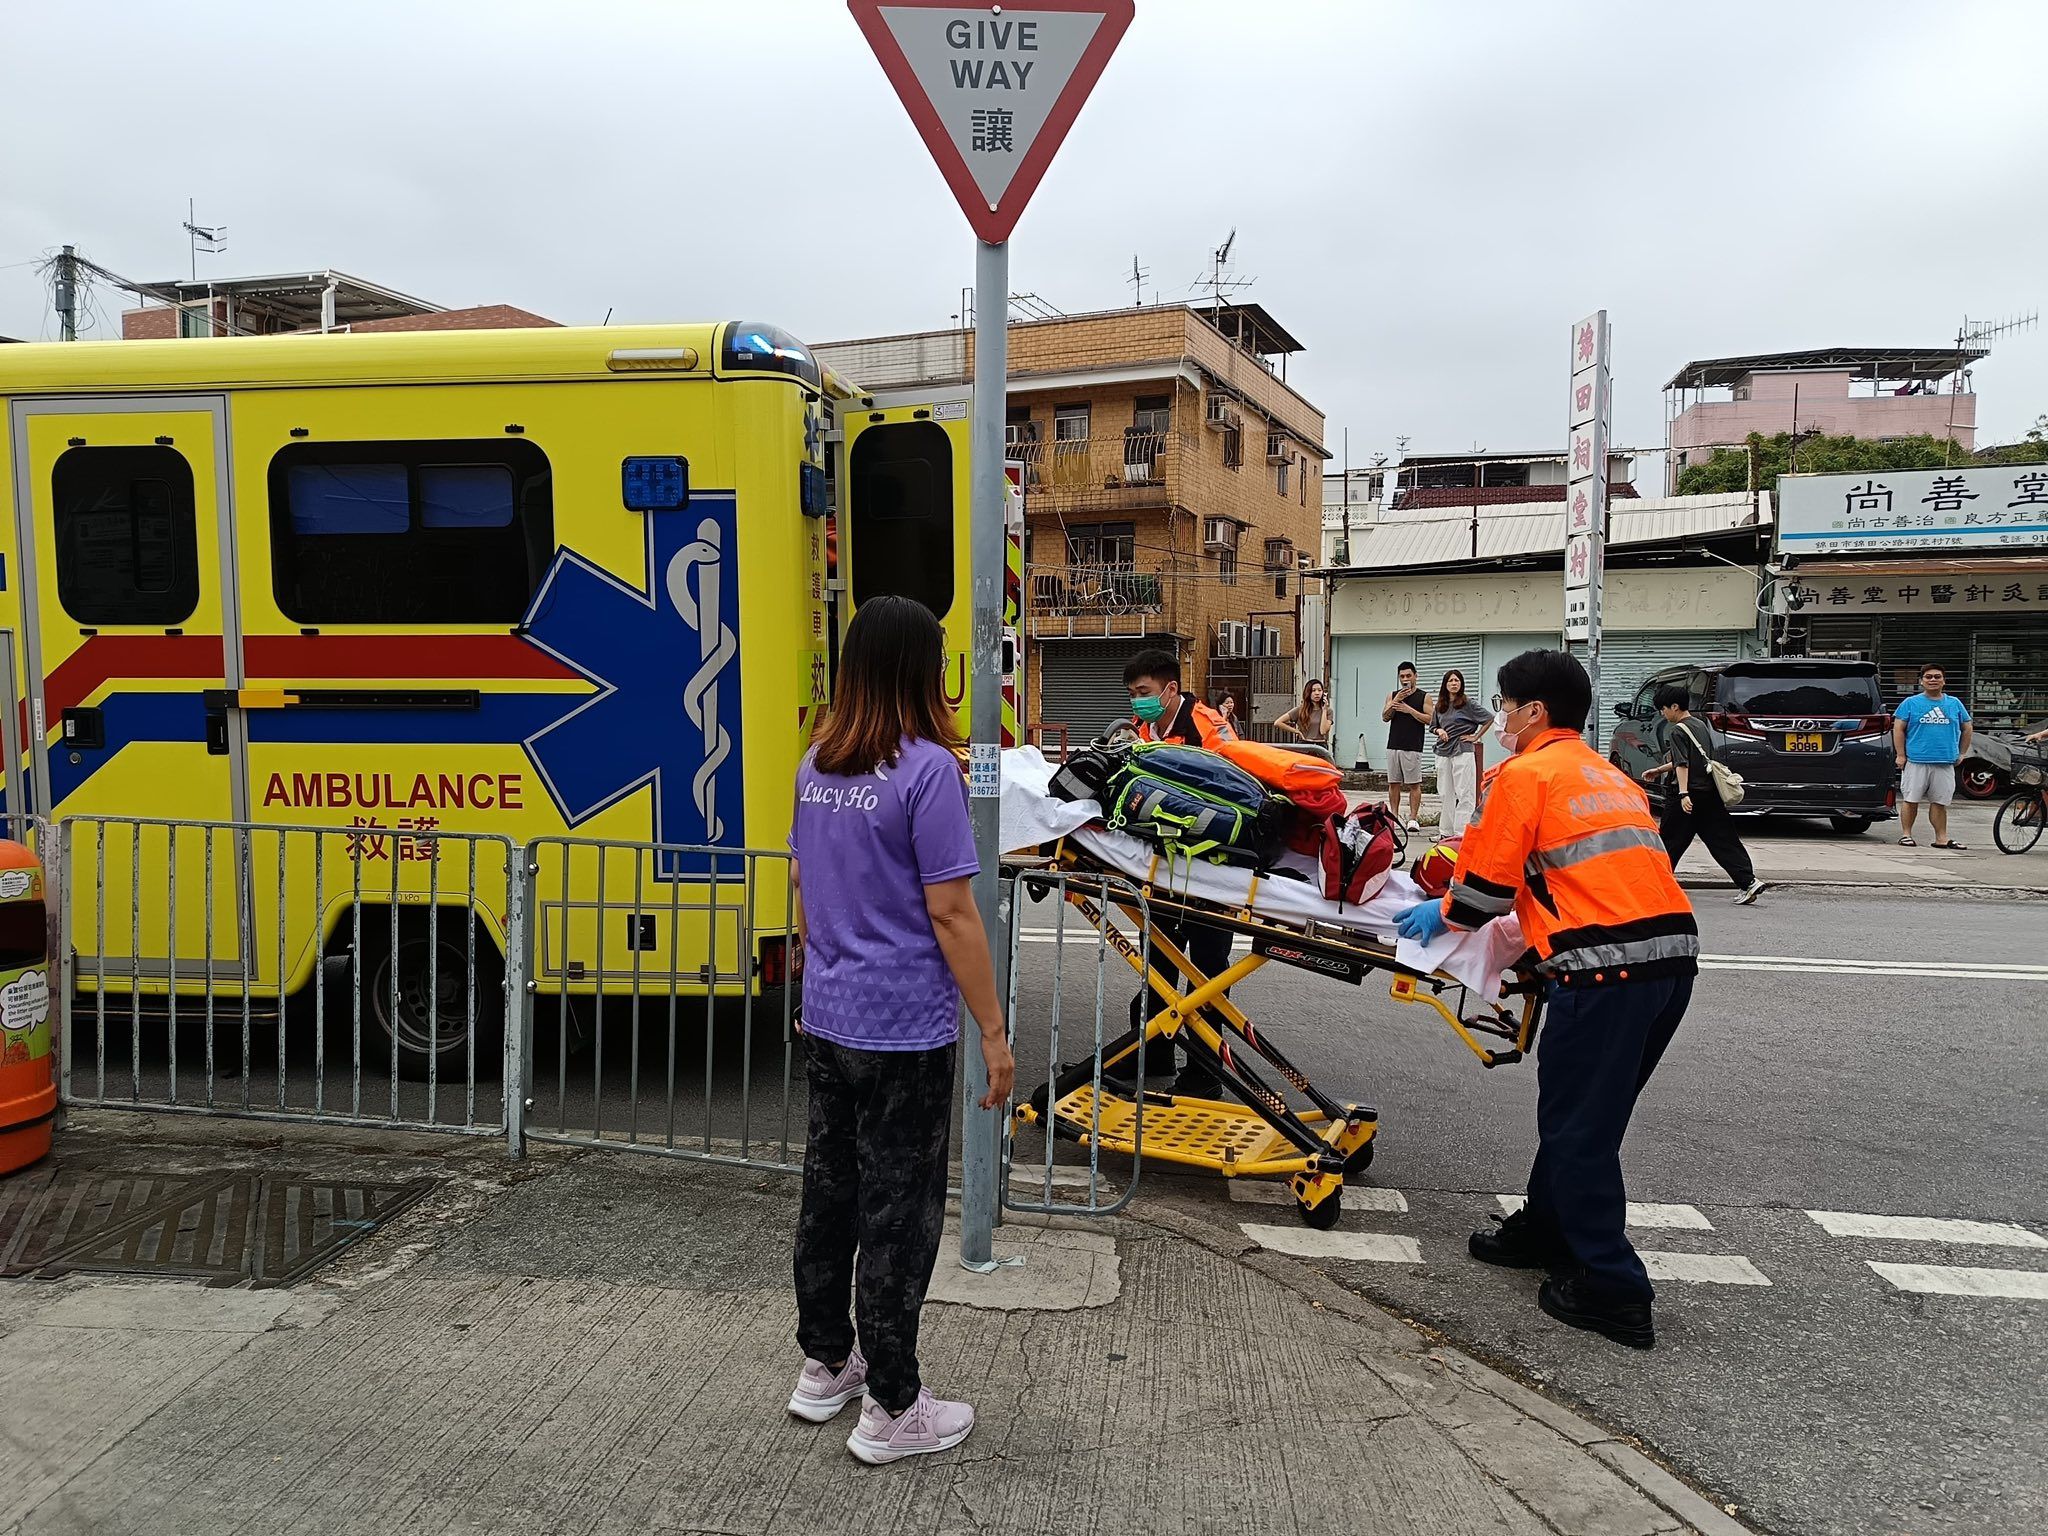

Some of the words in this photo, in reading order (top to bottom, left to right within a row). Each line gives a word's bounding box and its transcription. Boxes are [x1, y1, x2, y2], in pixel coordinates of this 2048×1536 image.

[945, 19, 1039, 51] GIVE
[949, 59, 1035, 90] WAY
[970, 107, 1014, 153] 讓
[1569, 322, 1596, 580] 錦田祠堂村
[1845, 472, 2048, 514] 尚善堂
[1847, 515, 1935, 530] 尚古善治
[1919, 716, 1950, 725] adidas
[1789, 742, 1819, 752] 3088
[1796, 734, 1809, 743] PT
[262, 772, 523, 810] AMBULANCE
[800, 781, 845, 812] Lucy
[845, 785, 879, 811] Ho
[345, 816, 442, 862] 救護
[385, 893, 403, 901] 40
[404, 893, 420, 902] kPa
[1076, 900, 1139, 958] styker
